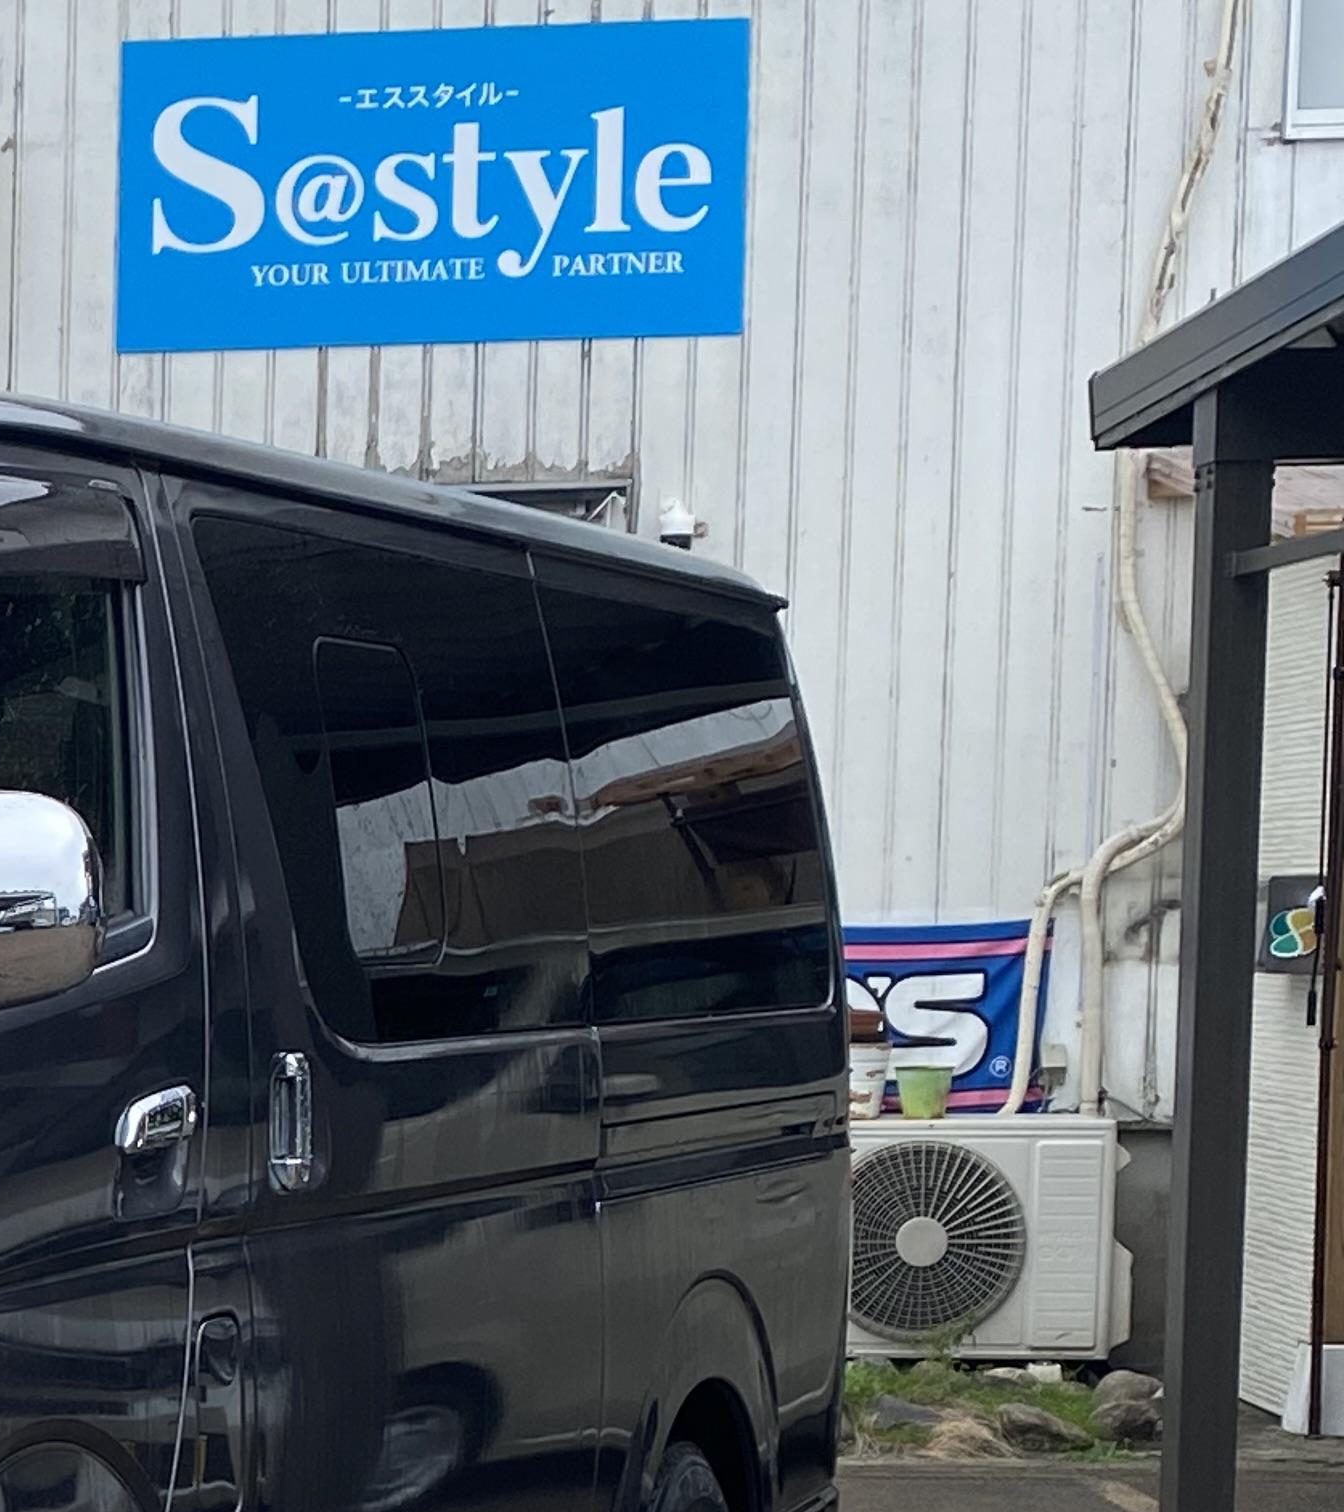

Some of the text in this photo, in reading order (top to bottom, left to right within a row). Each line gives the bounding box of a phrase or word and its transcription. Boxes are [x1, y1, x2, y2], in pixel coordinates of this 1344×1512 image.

[151, 94, 712, 279] S@style
[251, 251, 684, 288] YOUR ULTIMATE PARTNER
